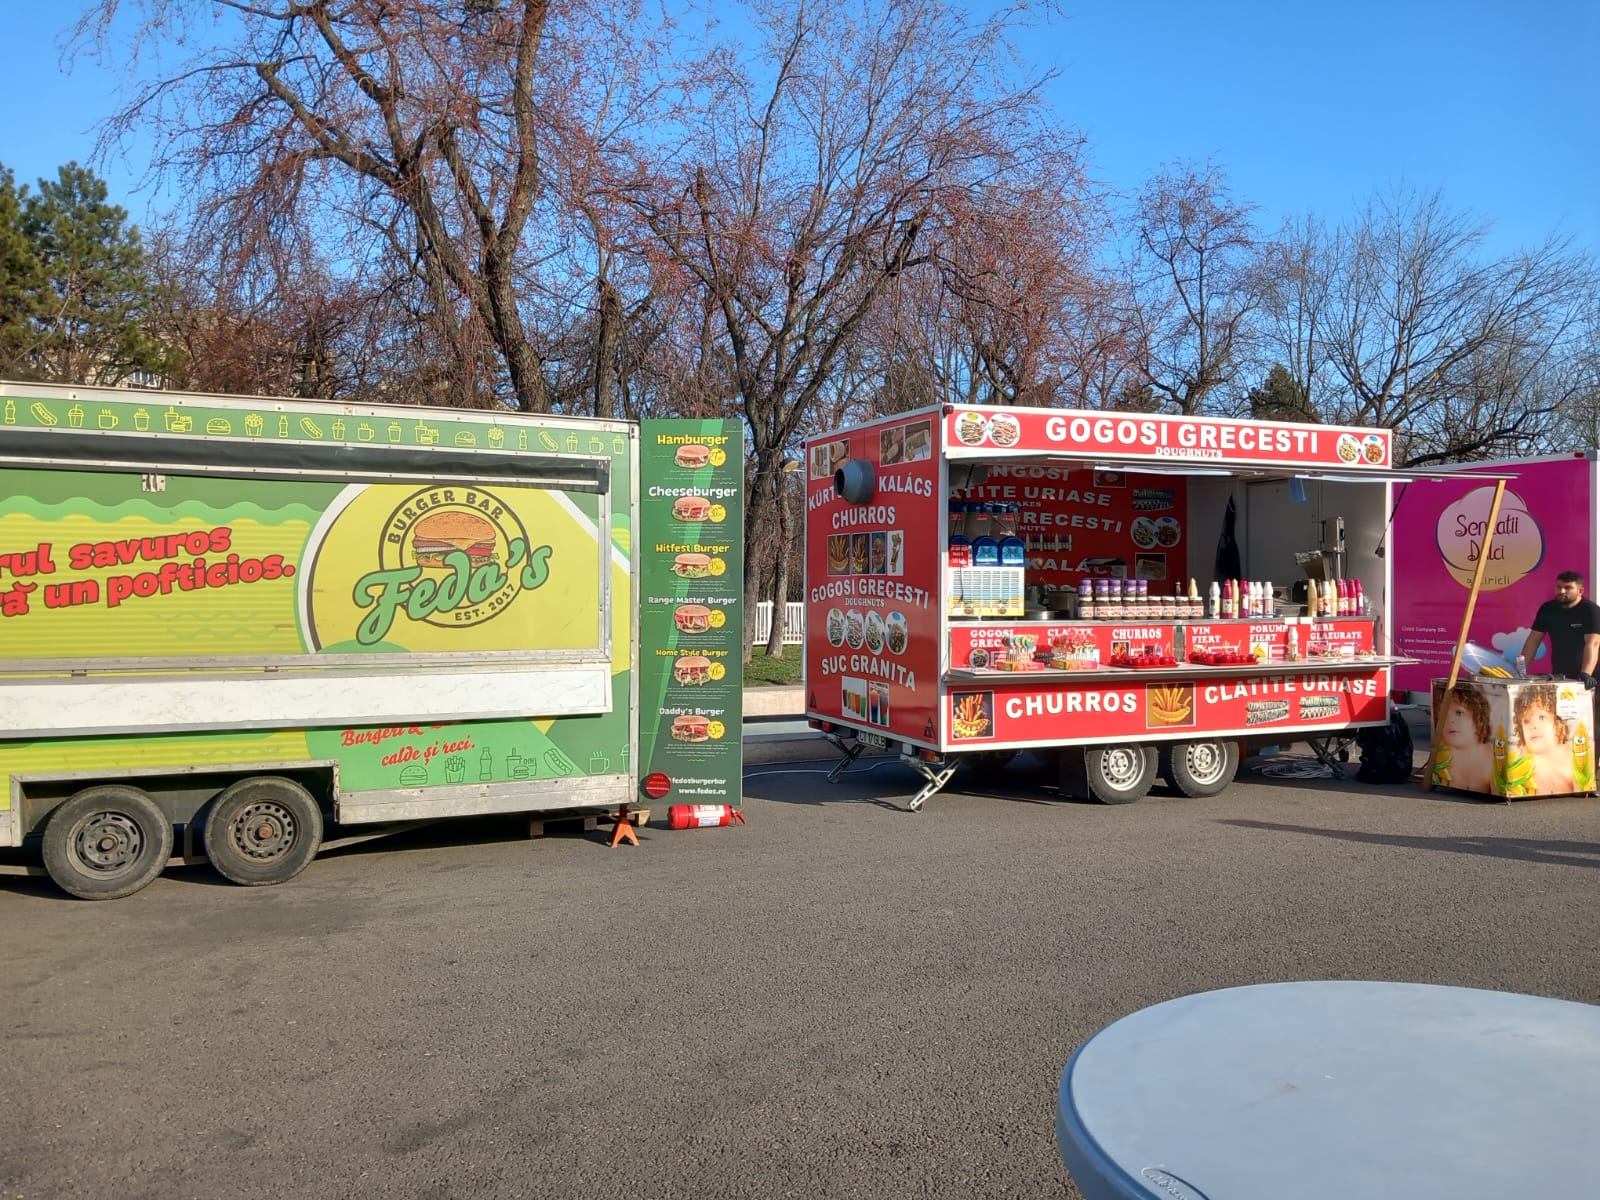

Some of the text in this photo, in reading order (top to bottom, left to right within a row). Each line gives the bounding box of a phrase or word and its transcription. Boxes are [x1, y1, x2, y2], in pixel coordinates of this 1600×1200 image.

[657, 434, 729, 447] Hamburger
[1045, 417, 1318, 453] GOGOSI GRECESTI
[1155, 446, 1223, 458] DOUGHNUTS
[988, 464, 1069, 481] NGOSI
[648, 486, 737, 499] Cheeseburger
[808, 472, 933, 511] KÜRT KALÁCS
[949, 486, 1112, 506] ATITE URIASE
[387, 489, 504, 545] BURGER BAR
[832, 506, 896, 529] CHURROS
[1017, 512, 1122, 533] RECESTI
[1455, 514, 1519, 537] Senatii
[69, 526, 232, 570] savuros
[655, 543, 730, 554] Hitfest Burger
[1467, 539, 1504, 561] Dlci
[44, 579, 99, 609] un
[106, 553, 296, 608] pofticios.
[454, 583, 515, 622] EST. 2017
[648, 597, 674, 605] Range
[707, 597, 737, 605] Burger
[811, 580, 855, 603] GOGOSI
[859, 578, 929, 609] GRECESTI
[845, 598, 885, 607] DOUGHNUTS
[970, 629, 1014, 638] GOGOSI
[1112, 629, 1162, 640] CHURROS
[1192, 626, 1210, 634] VIN
[1192, 635, 1221, 644] FIERT
[1250, 633, 1277, 642] FIERT
[1310, 631, 1363, 641] GLAZURATE
[970, 639, 1004, 648] GREC
[822, 655, 916, 692] SUC GRANITA
[1205, 674, 1377, 704] CLATITE URIASE
[659, 707, 725, 717] Daddy's Burger
[1006, 692, 1137, 719] CHURROS
[381, 744, 421, 767] calde
[442, 735, 476, 754] reci.
